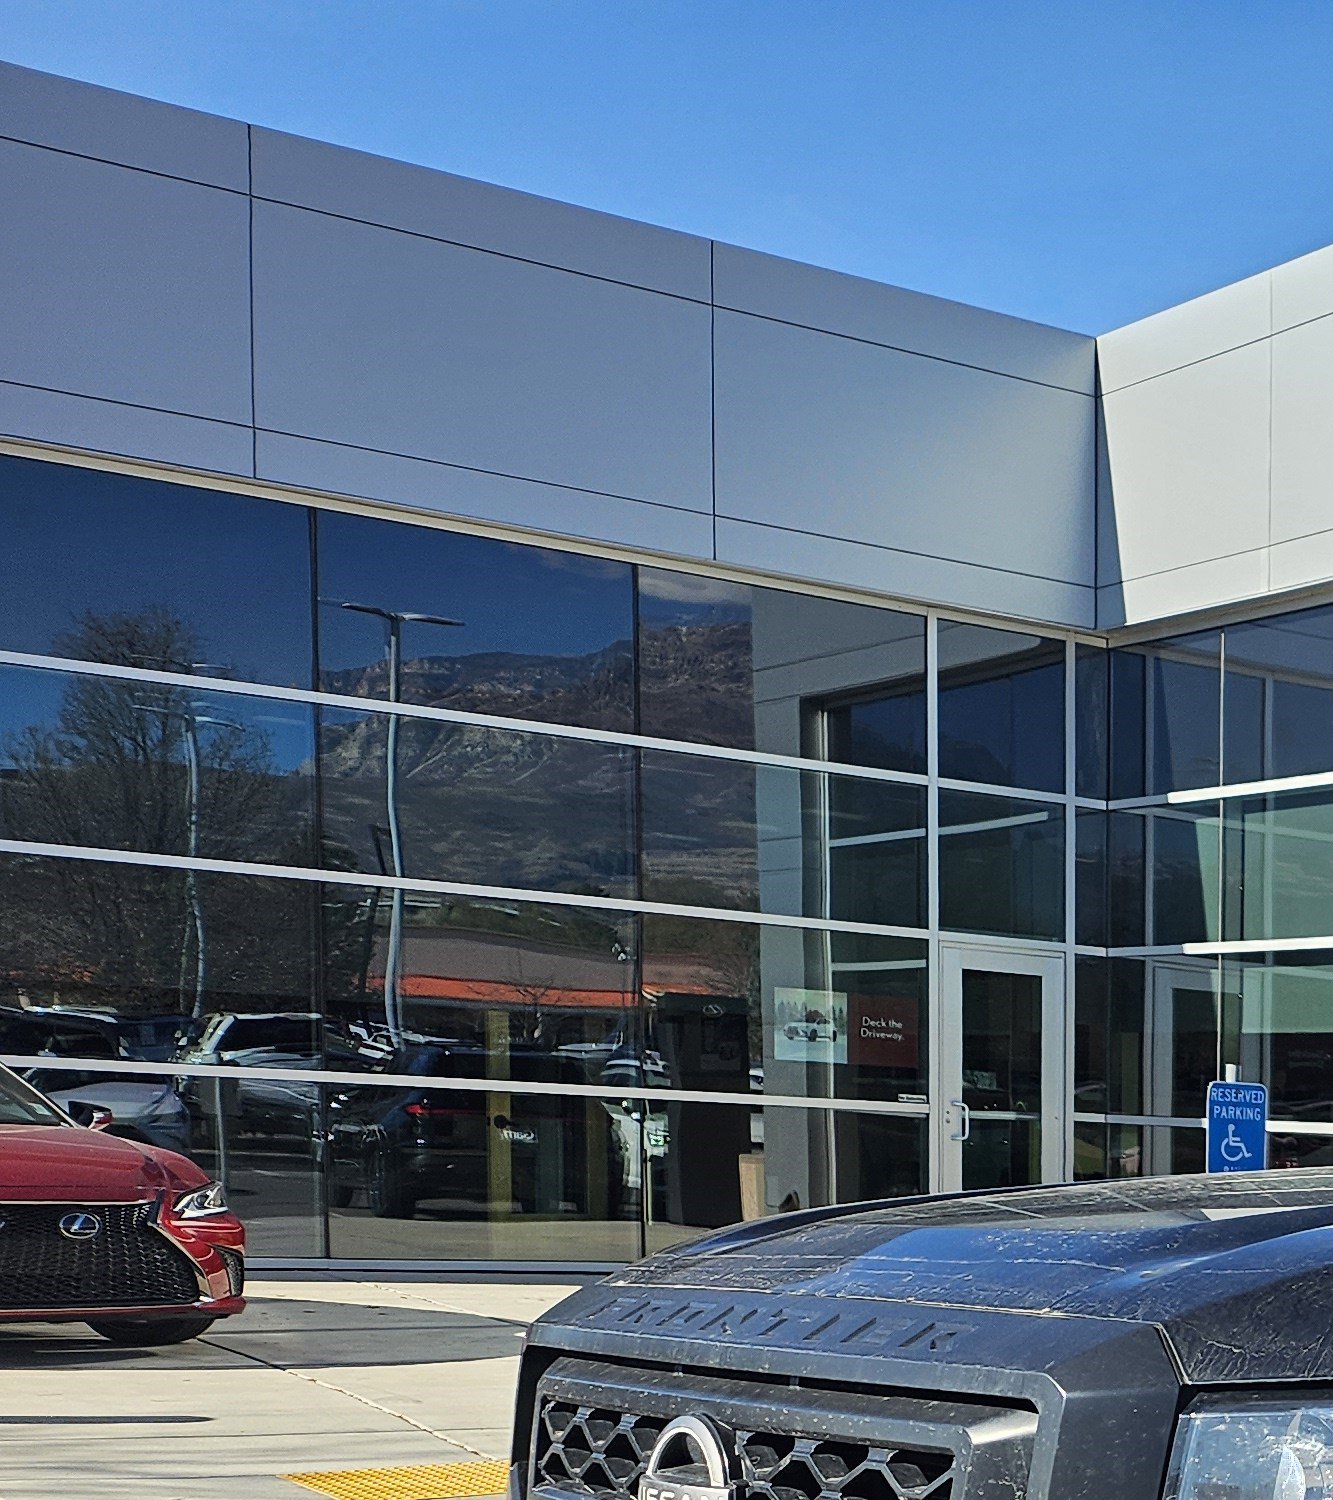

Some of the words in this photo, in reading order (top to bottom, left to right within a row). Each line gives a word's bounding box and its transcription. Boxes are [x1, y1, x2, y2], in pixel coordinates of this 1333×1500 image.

[862, 1016, 887, 1028] Deck
[1210, 1087, 1265, 1104] RESERVED
[1213, 1105, 1261, 1121] PARKING
[585, 1296, 978, 1353] FRONTIER
